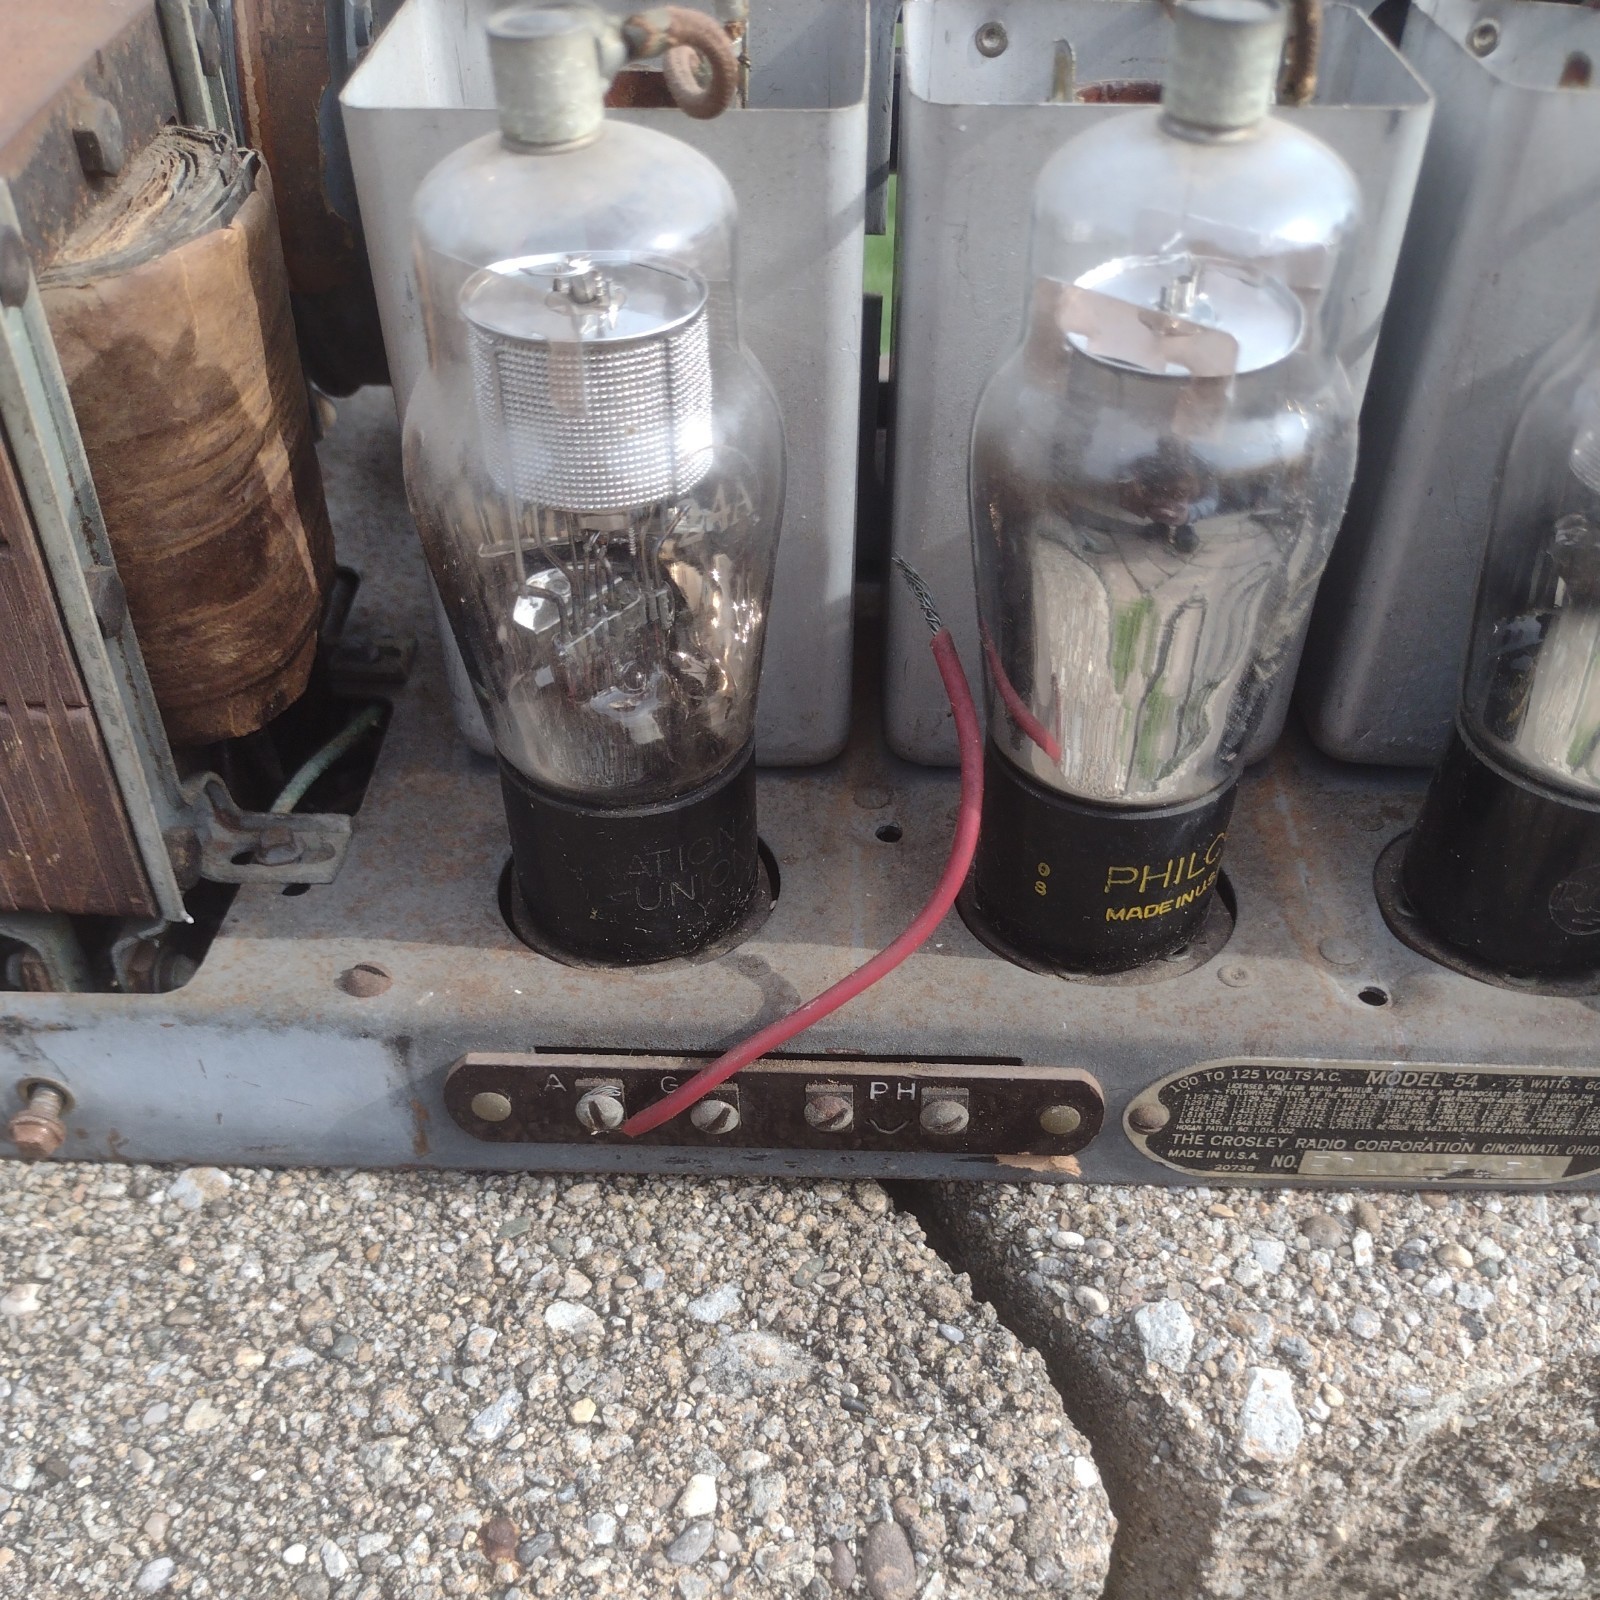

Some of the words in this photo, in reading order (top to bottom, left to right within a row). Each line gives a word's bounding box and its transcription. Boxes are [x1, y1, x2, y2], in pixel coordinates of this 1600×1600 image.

[1104, 832, 1228, 893] PHILC
[1106, 899, 1174, 921] MADE
[1175, 890, 1194, 909] IN
[544, 1073, 567, 1092] A
[660, 1076, 679, 1094] G
[869, 1081, 916, 1100] PH
[1169, 1076, 1199, 1093] 100
[1203, 1071, 1225, 1082] TO
[1231, 1069, 1260, 1080] 125
[1265, 1070, 1312, 1081] VOLTS
[1313, 1071, 1341, 1082] A.C.
[1365, 1070, 1443, 1087] MODEL
[1452, 1074, 1480, 1088] 54
[1505, 1078, 1525, 1088] 75
[1530, 1079, 1571, 1090] WATTS
[1171, 1133, 1206, 1146] THE
[1210, 1135, 1289, 1148] CROSLEY
[1295, 1138, 1347, 1150] RADIO
[1354, 1139, 1475, 1153] CORPORATION
[1168, 1149, 1204, 1158] MADE
[1206, 1150, 1220, 1159] IN
[1224, 1151, 1260, 1160] U.S.A.
[1270, 1154, 1298, 1169] NO.
